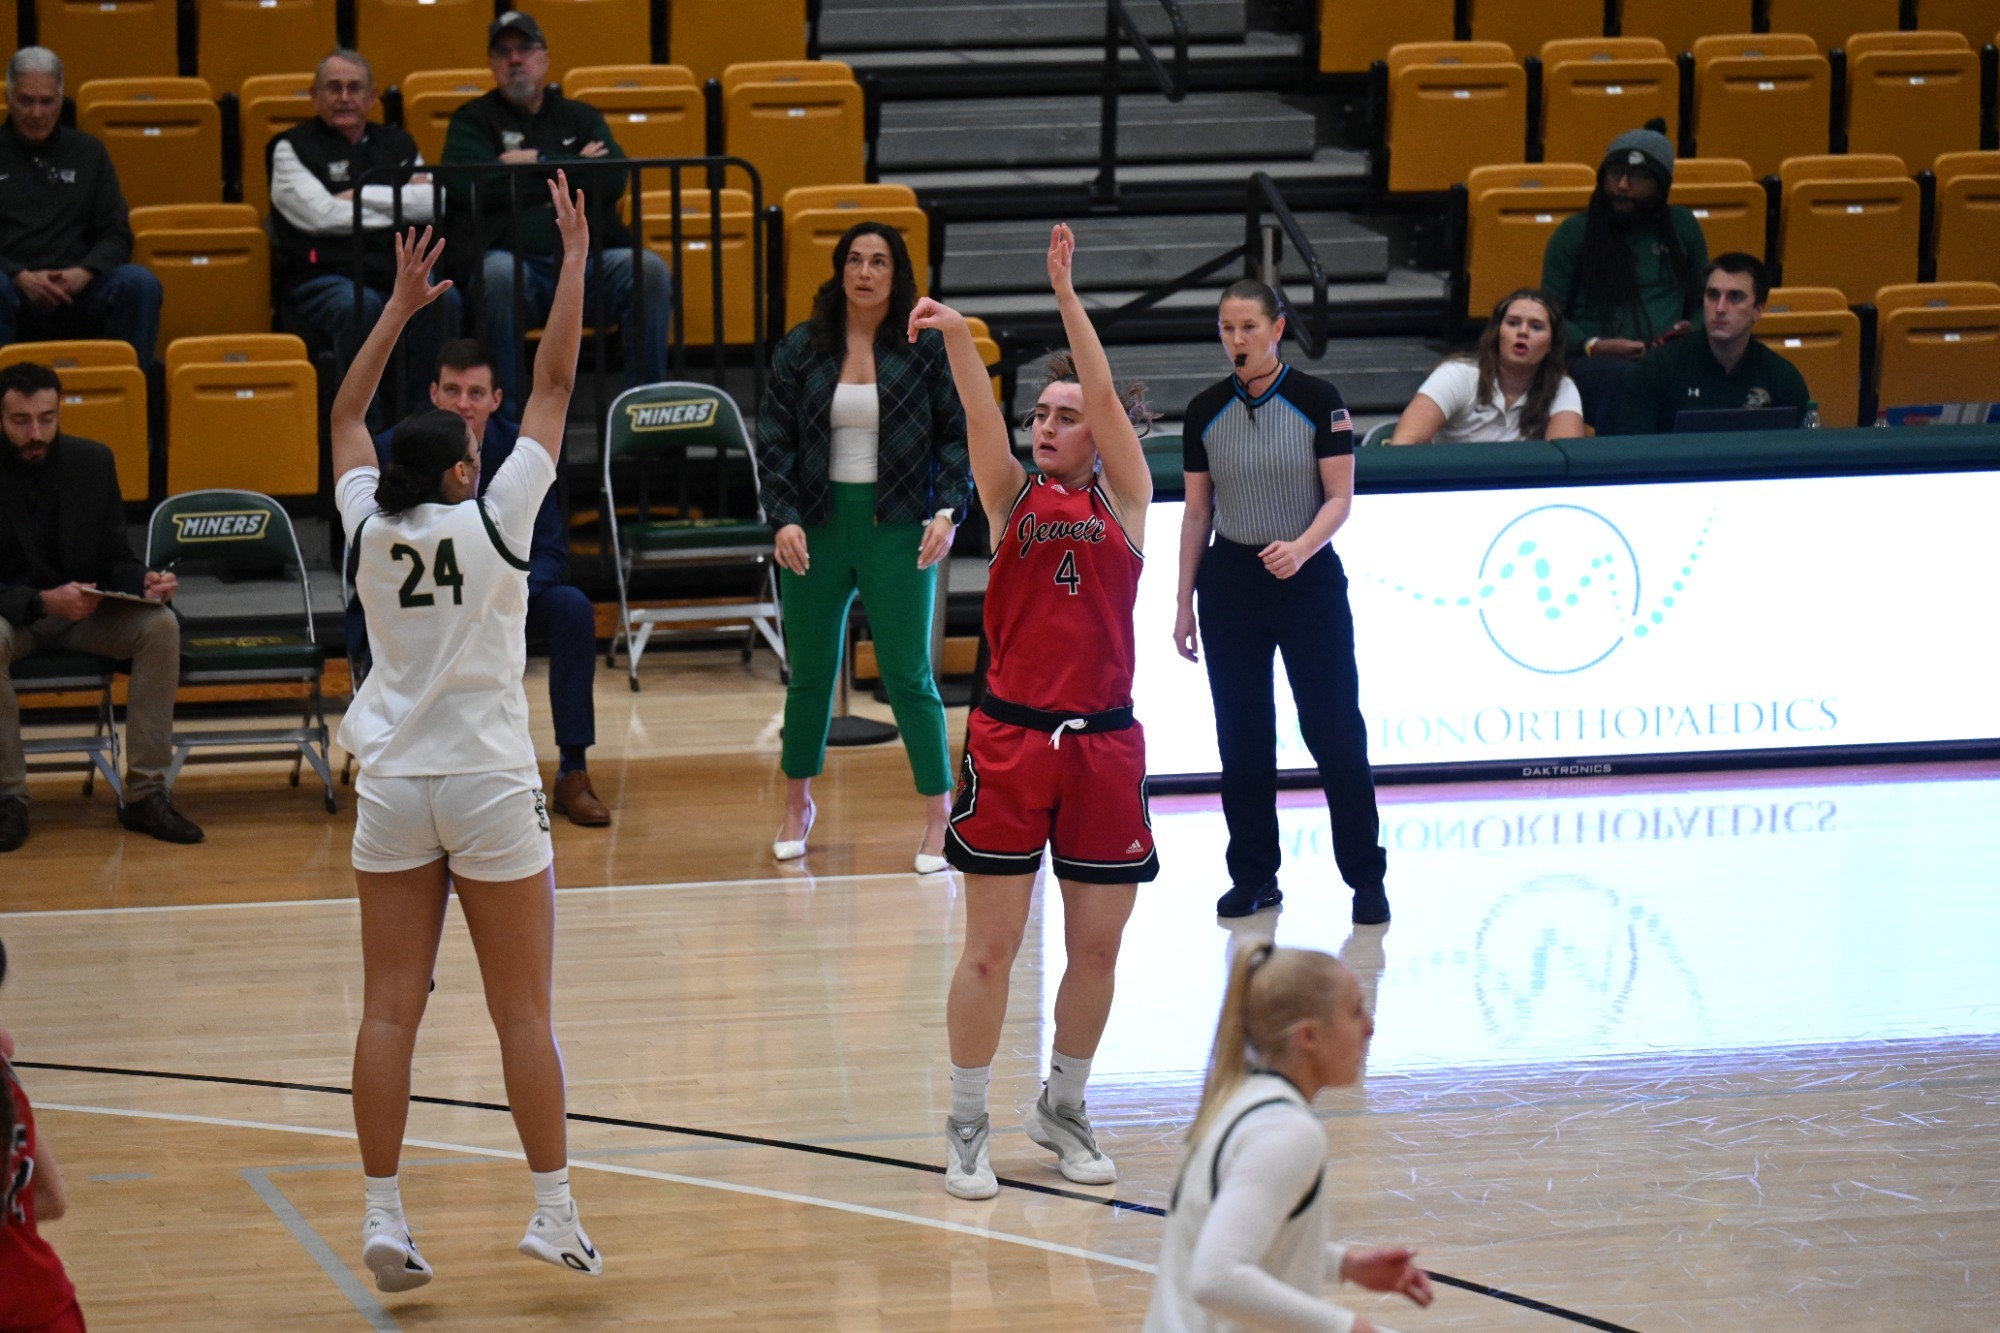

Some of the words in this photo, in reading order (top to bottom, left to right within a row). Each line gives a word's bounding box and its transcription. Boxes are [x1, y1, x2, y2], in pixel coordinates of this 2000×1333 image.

[637, 402, 711, 425] MINERS
[183, 514, 262, 536] MINERS
[1017, 512, 1105, 558] Jewell
[390, 537, 463, 608] 24
[1054, 550, 1080, 595] 4
[1523, 764, 1612, 777] DAKTRONICS
